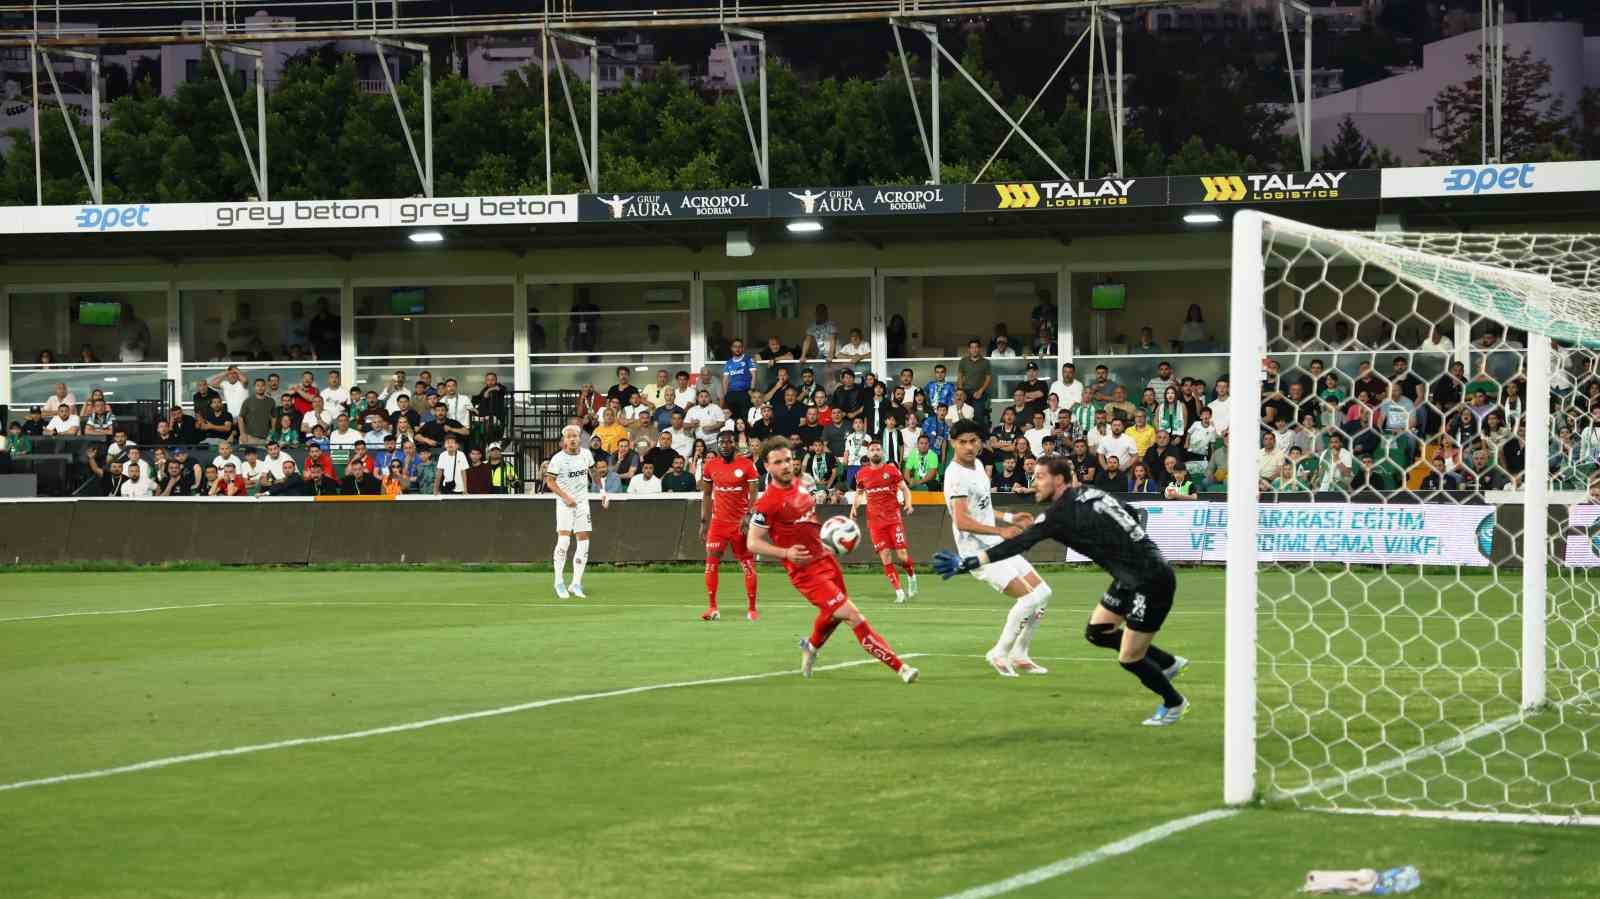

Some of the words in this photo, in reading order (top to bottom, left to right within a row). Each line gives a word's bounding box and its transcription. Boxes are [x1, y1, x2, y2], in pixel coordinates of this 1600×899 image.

[1247, 171, 1348, 192] TALAY
[1443, 163, 1536, 194] opet
[829, 190, 853, 199] GRUP
[873, 189, 944, 204] ACROPOL
[1040, 179, 1136, 199] TALAY
[1253, 190, 1339, 200] LOGISTICS
[637, 195, 661, 204] GRUP
[680, 194, 749, 209] ACROPOL
[818, 198, 865, 212] AURA
[889, 202, 927, 211] BODRUM
[1046, 197, 1128, 208] LOGISTICS
[216, 206, 285, 227] grey
[294, 202, 379, 221] beton
[400, 201, 470, 224] grey
[479, 197, 566, 217] beton
[626, 203, 673, 217] AURA
[696, 207, 732, 216] BODRUM
[75, 204, 151, 232] opet
[1190, 533, 1217, 551] VE
